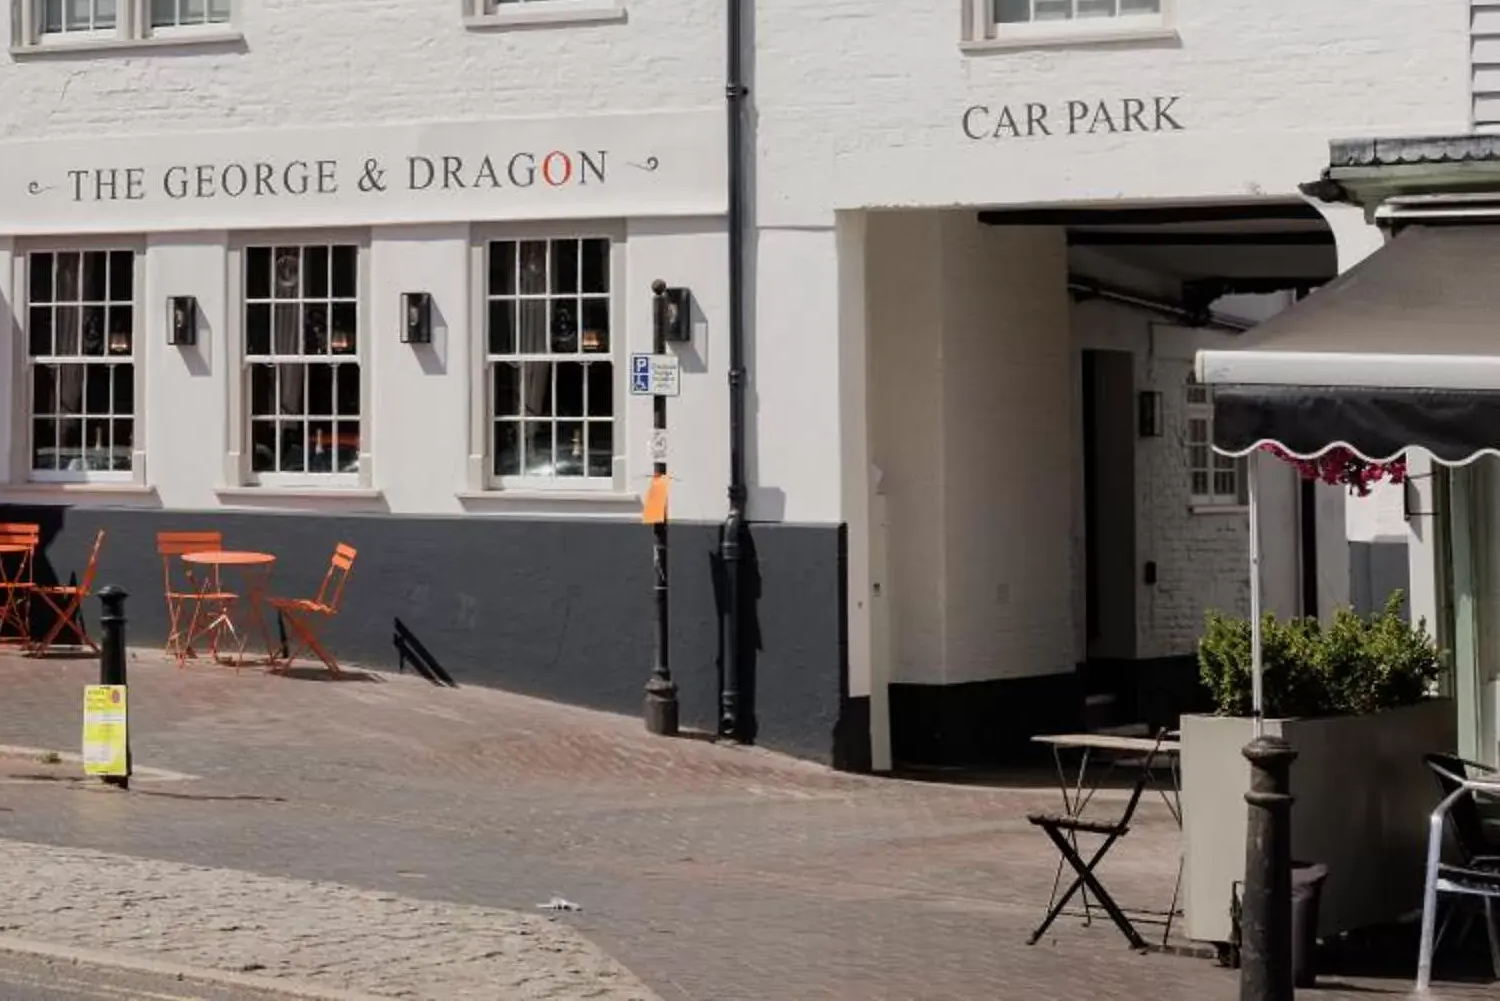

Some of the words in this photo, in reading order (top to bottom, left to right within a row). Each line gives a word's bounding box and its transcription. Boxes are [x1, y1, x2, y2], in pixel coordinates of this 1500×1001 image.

[962, 103, 1052, 140] CAR
[1066, 96, 1186, 135] PARK
[67, 168, 147, 202] THE
[164, 159, 338, 198] GEORGE
[357, 158, 387, 192] &
[408, 150, 609, 191] DRAGON
